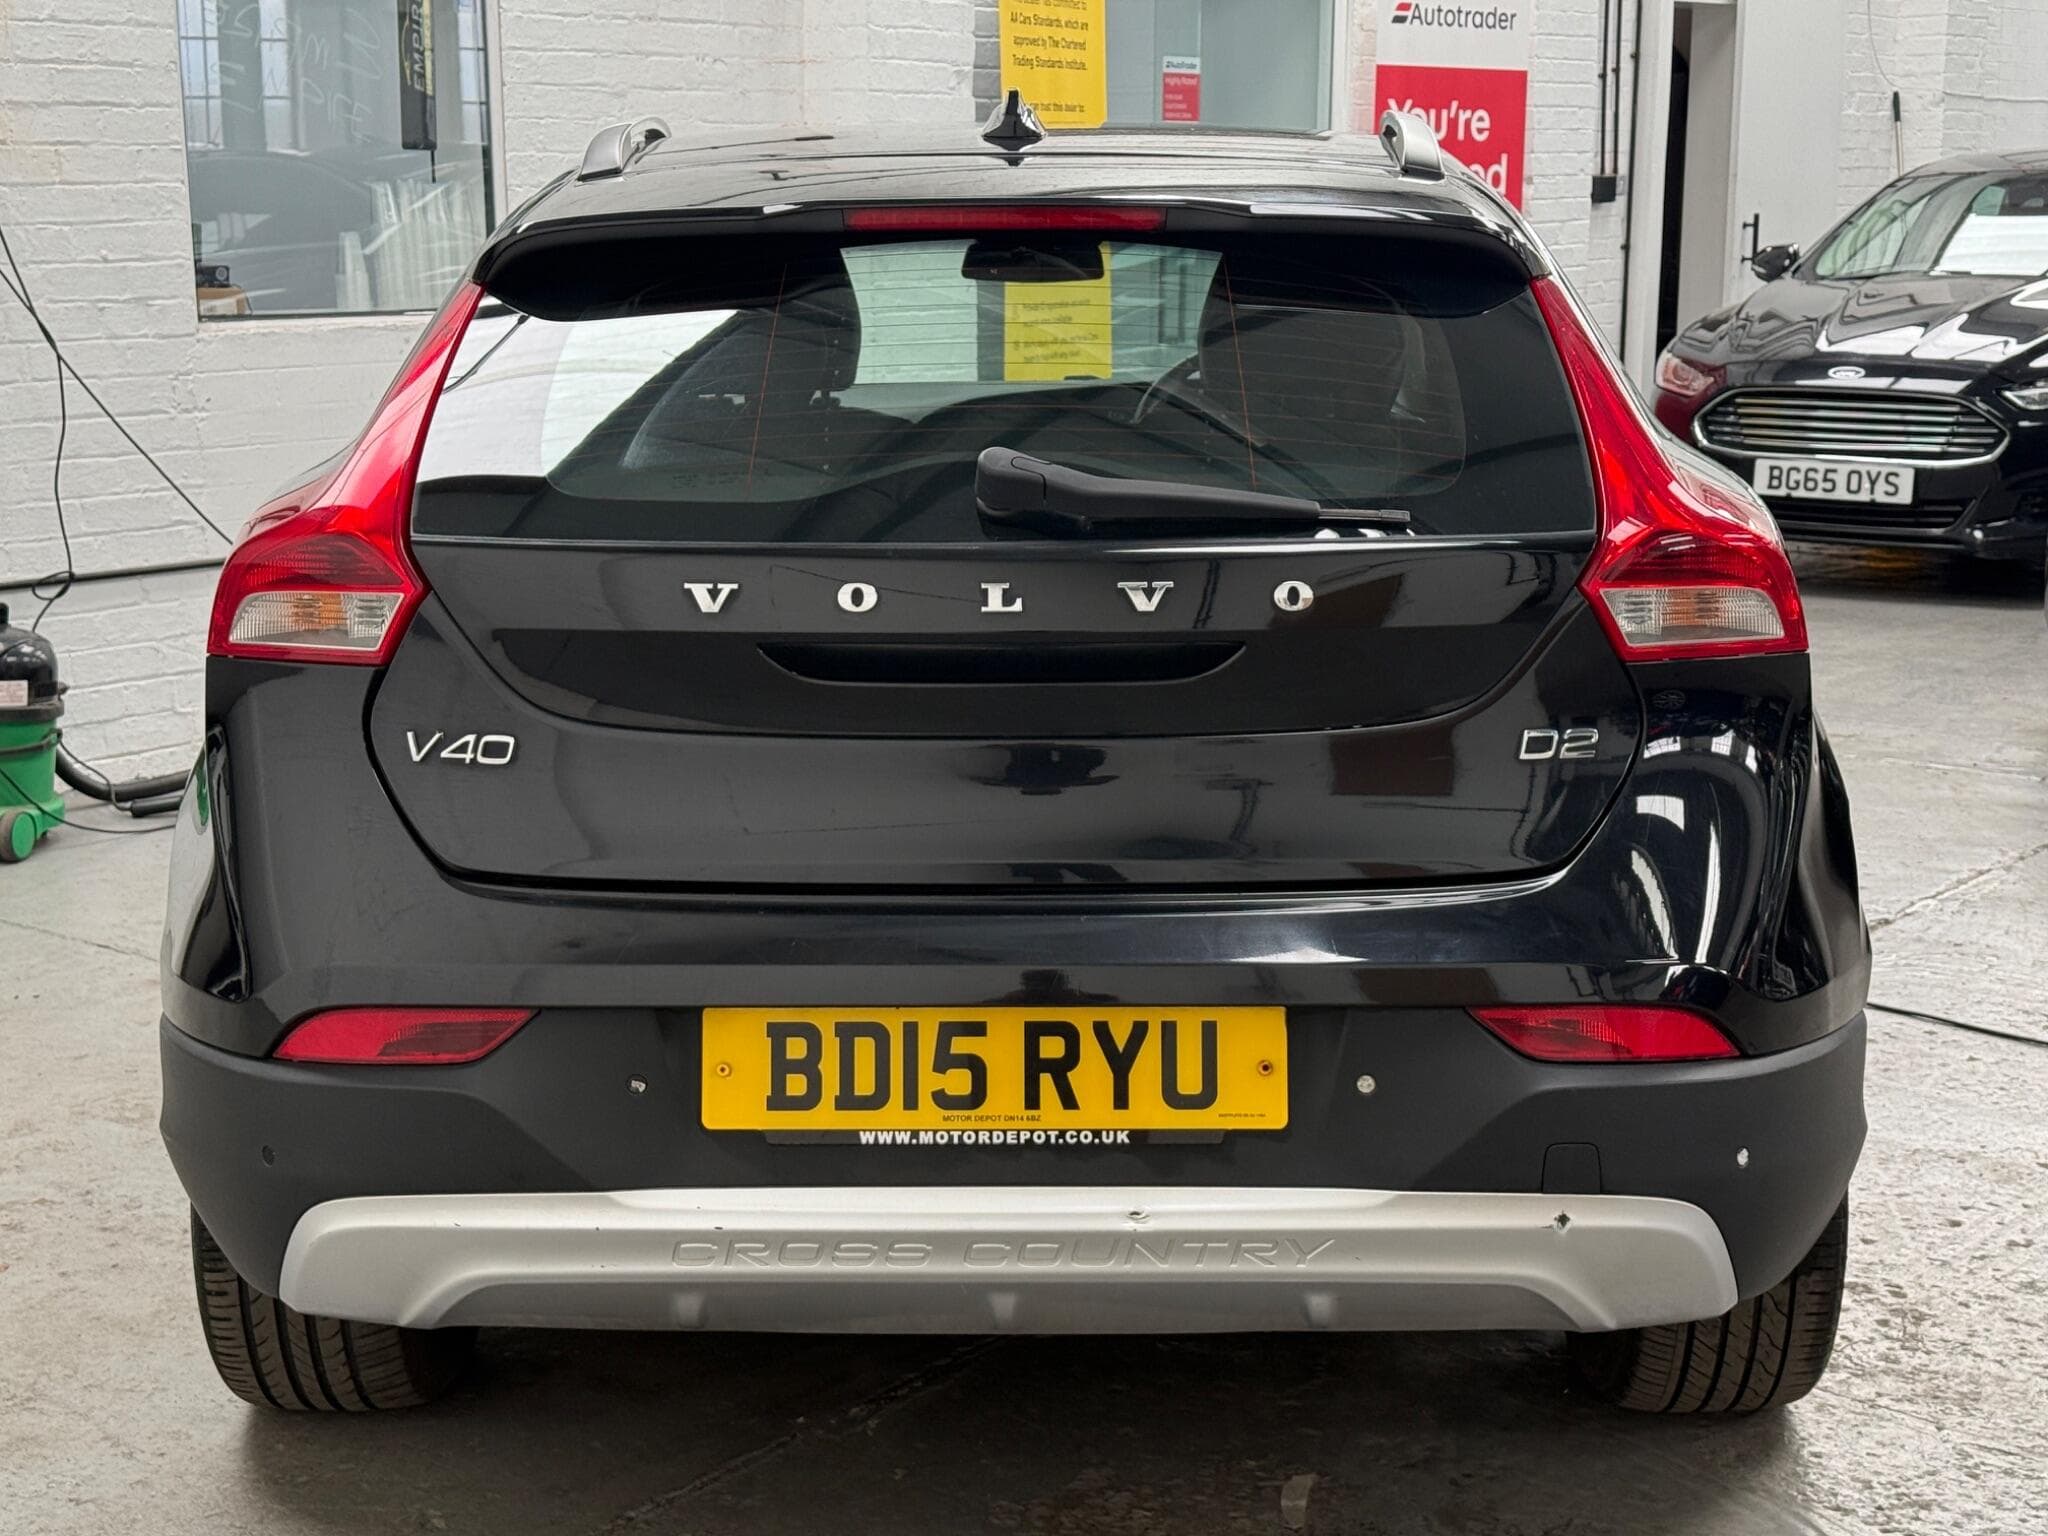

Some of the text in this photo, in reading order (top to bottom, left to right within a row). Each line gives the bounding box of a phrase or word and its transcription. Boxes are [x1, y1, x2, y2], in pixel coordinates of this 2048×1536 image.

[1019, 12, 1032, 25] Cars
[1080, 22, 1089, 31] are
[1410, 3, 1517, 31] Autotrader
[1013, 35, 1086, 50] approved by The Chartered
[1012, 54, 1034, 70] Trading
[1035, 56, 1064, 69] Standards
[1767, 465, 1901, 497] BG65 OYS
[684, 580, 1314, 613] VOLVO
[406, 730, 516, 766] V40
[1518, 728, 1600, 760] D2
[765, 1020, 1219, 1112] BD15 RYU
[942, 1114, 973, 1122] MOTOR
[974, 1114, 1002, 1122] DEPOT
[859, 1130, 1131, 1146] WWW.MOTORDEPOT.CO.UK
[670, 1238, 1338, 1268] CROSS COUNTRY
